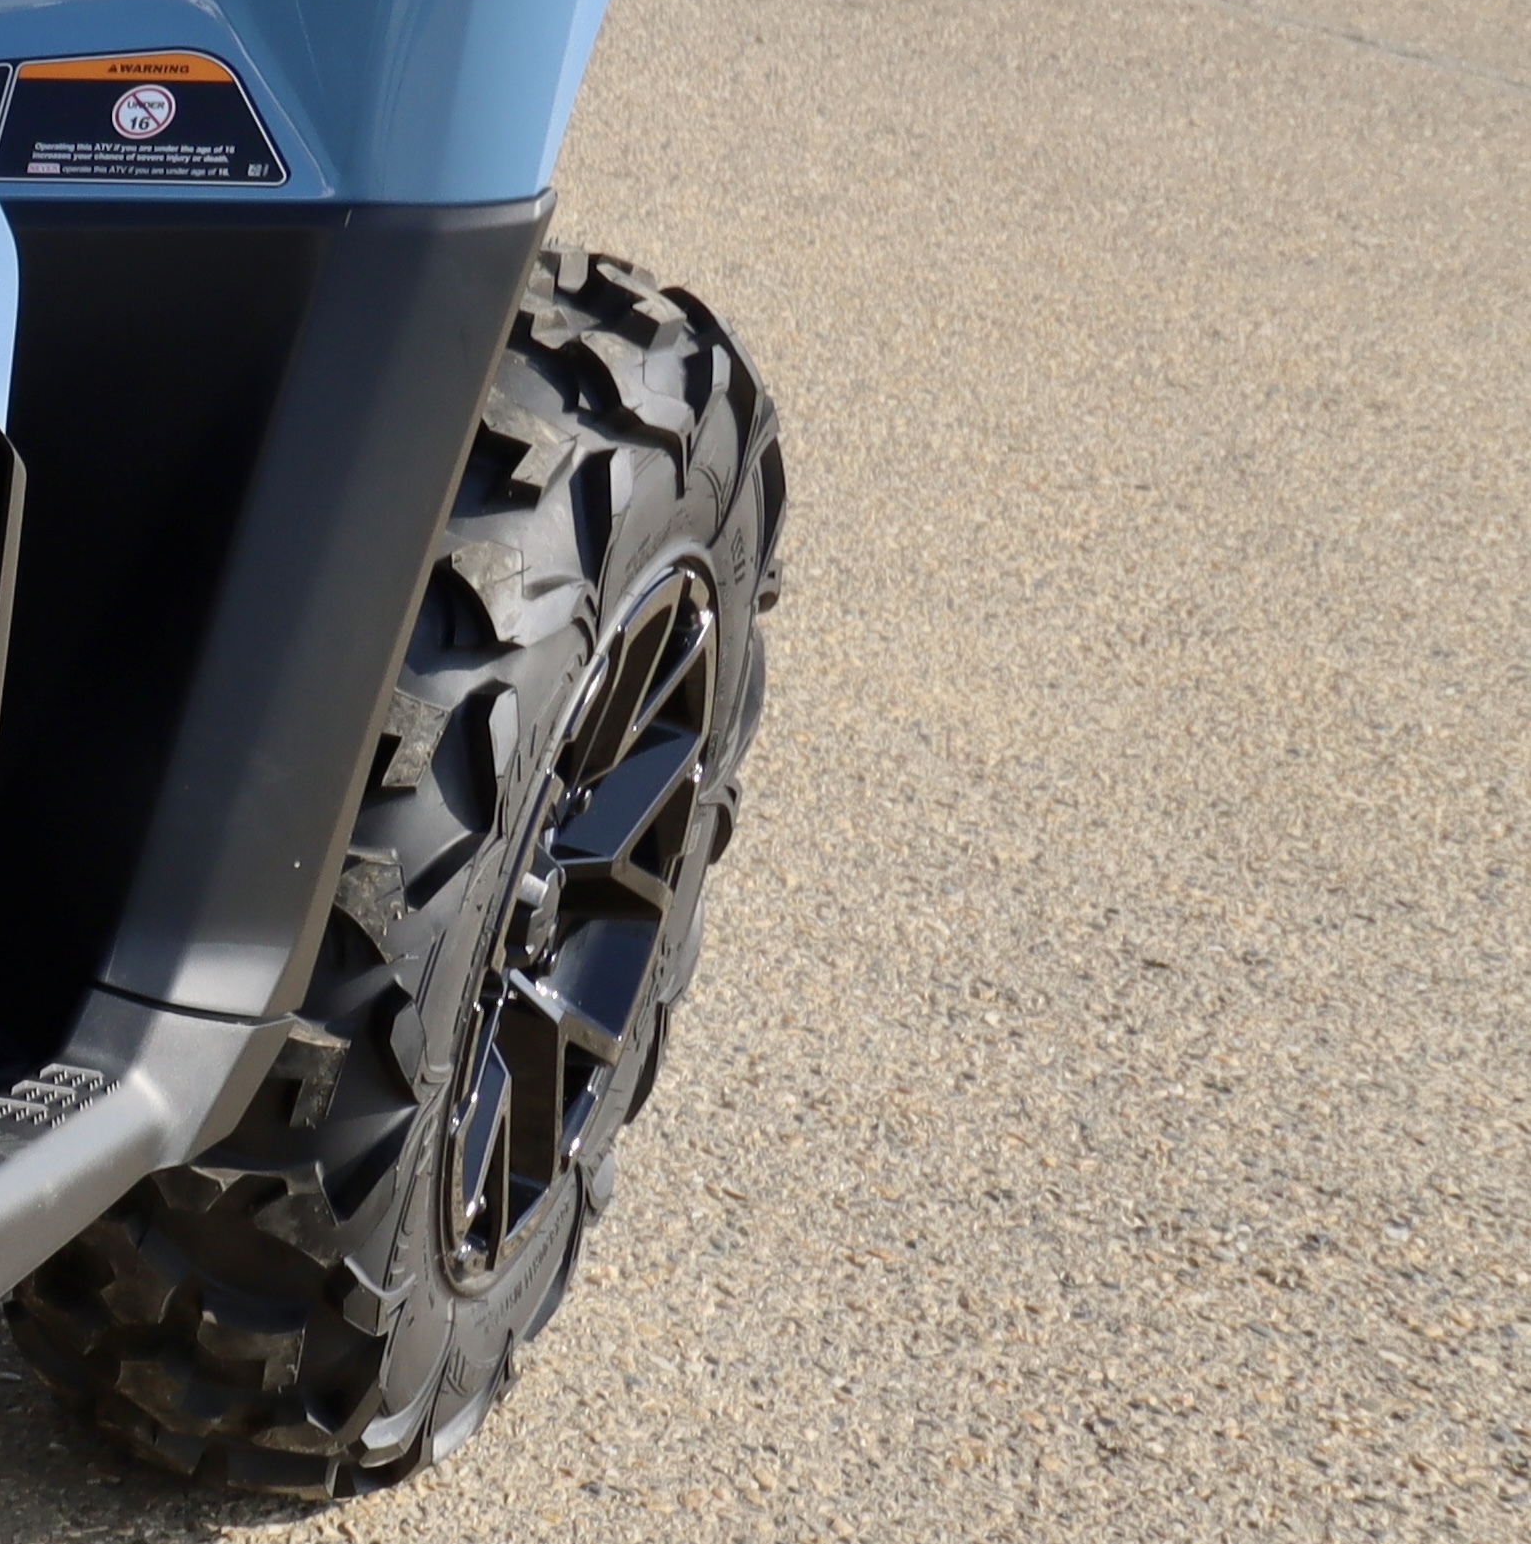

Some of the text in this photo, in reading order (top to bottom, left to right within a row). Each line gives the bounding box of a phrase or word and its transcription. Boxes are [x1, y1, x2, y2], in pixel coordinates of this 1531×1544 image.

[118, 63, 190, 74] WARNING
[127, 101, 165, 110] UNDER
[129, 117, 150, 130] 16
[35, 142, 75, 152] Operating
[77, 143, 92, 151] this
[94, 143, 113, 152] ATV
[121, 145, 137, 153] you
[154, 145, 179, 153] under
[181, 145, 194, 153] the
[213, 146, 223, 154] of
[126, 153, 135, 161] of
[109, 165, 126, 174] ATV
